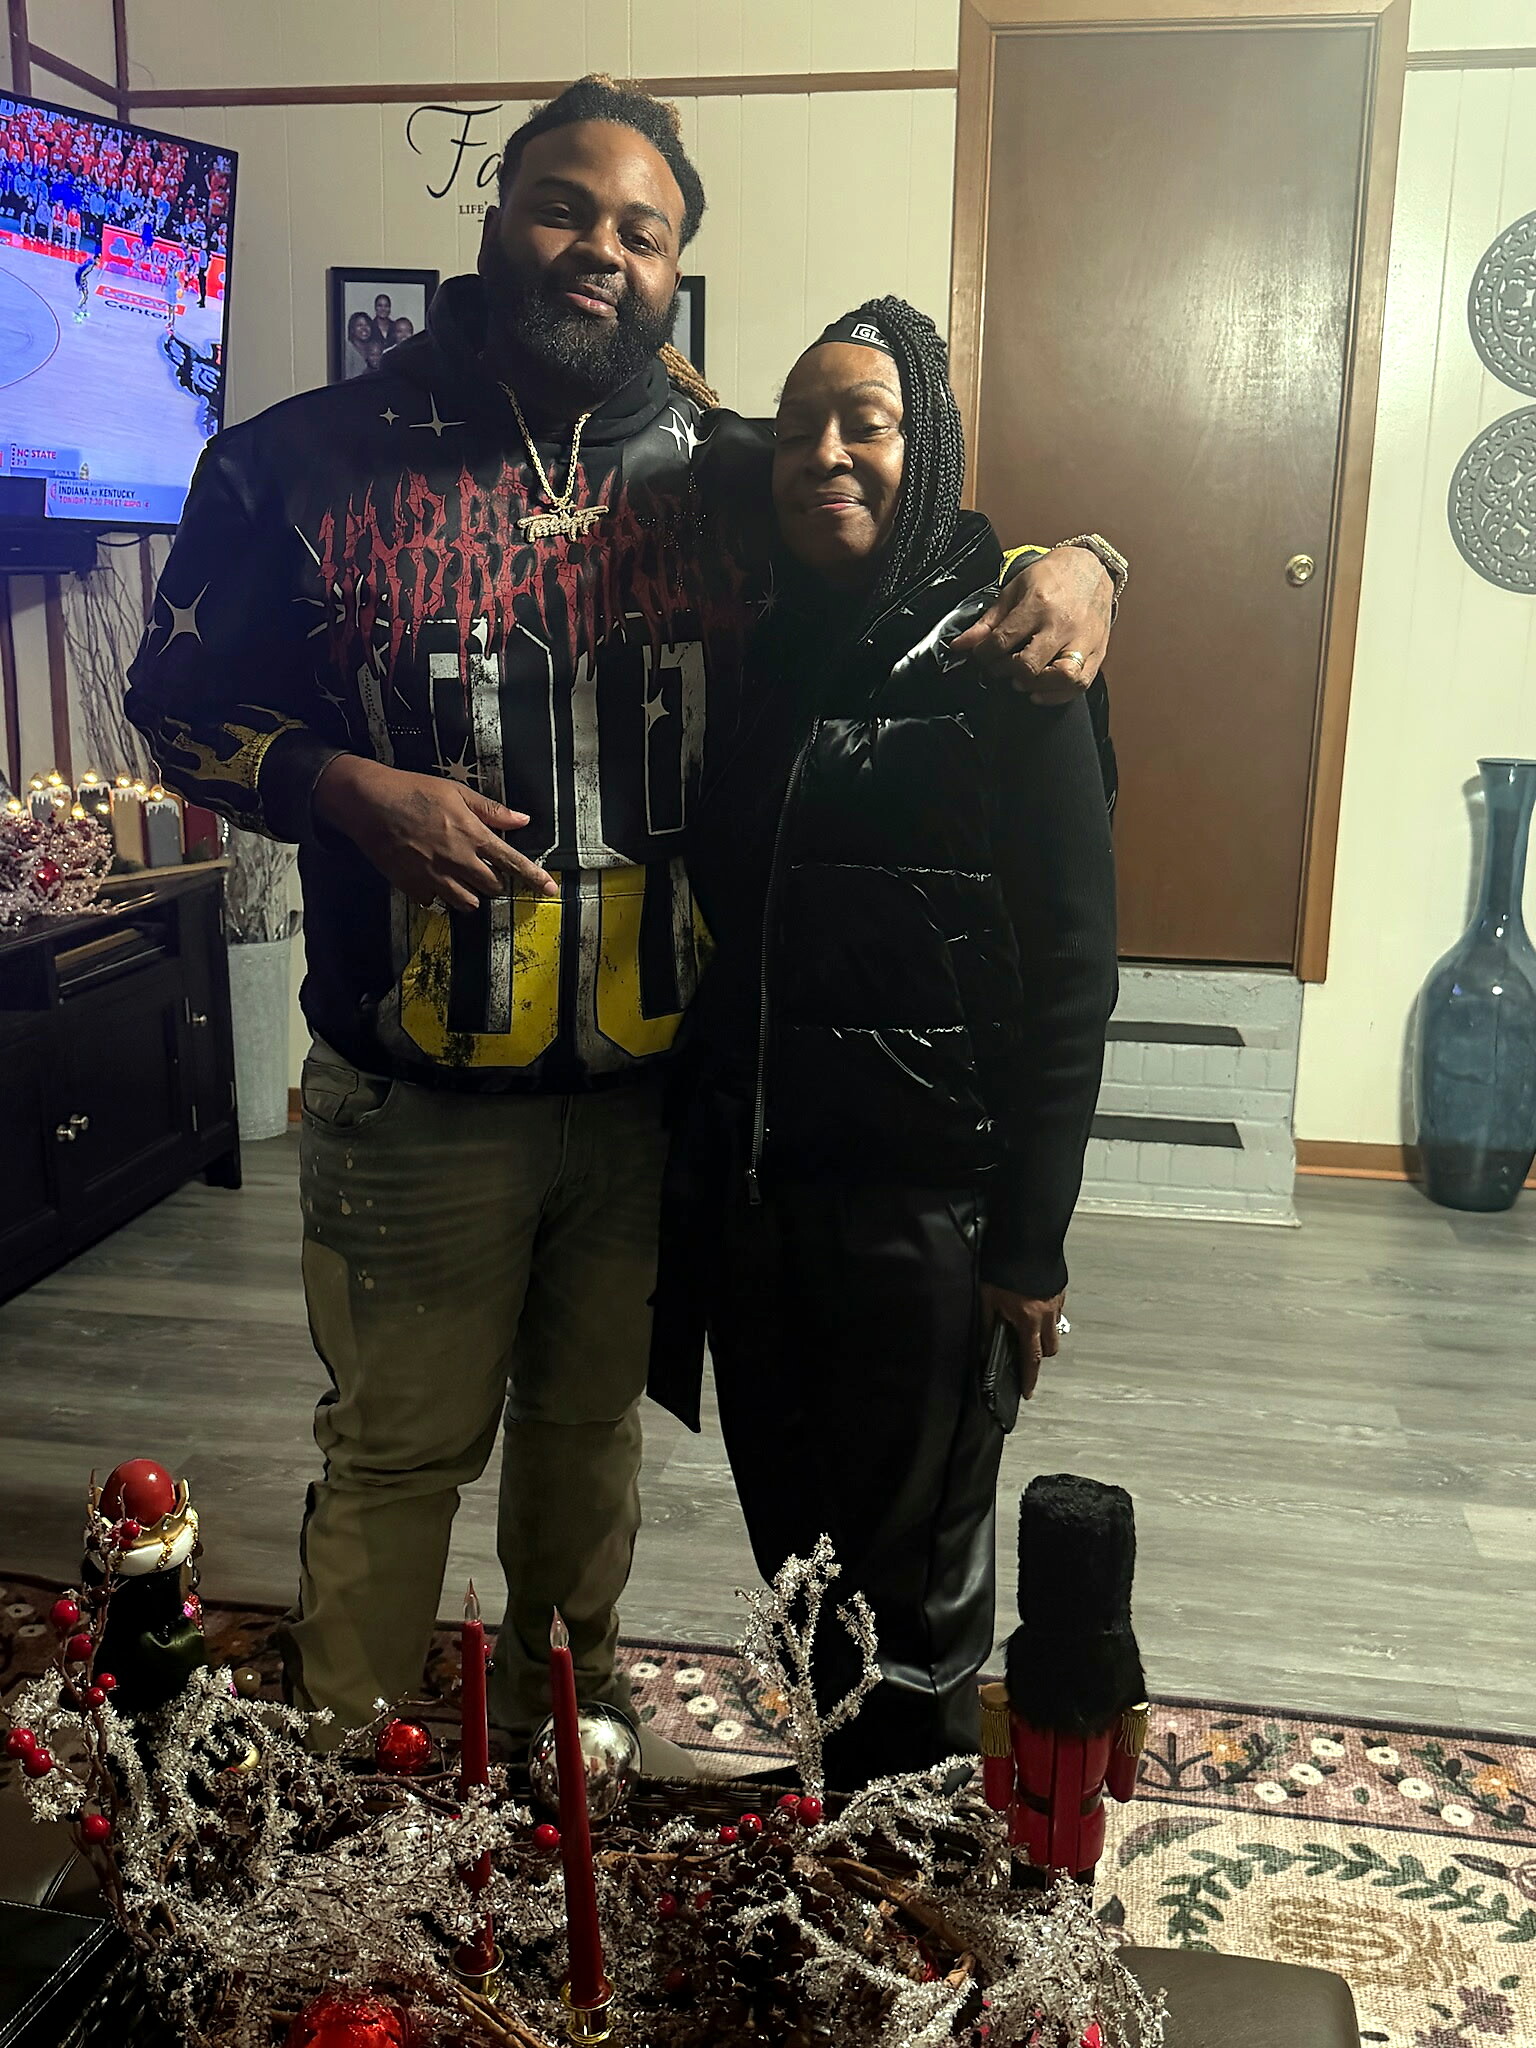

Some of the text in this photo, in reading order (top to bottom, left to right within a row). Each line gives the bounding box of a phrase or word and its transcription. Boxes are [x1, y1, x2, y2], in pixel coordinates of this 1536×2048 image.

[407, 104, 503, 199] Fa
[459, 200, 488, 215] LIFE'
[16, 448, 57, 460] NC STATE
[58, 485, 89, 496] INDIANA
[100, 488, 135, 499] KENTUCKY
